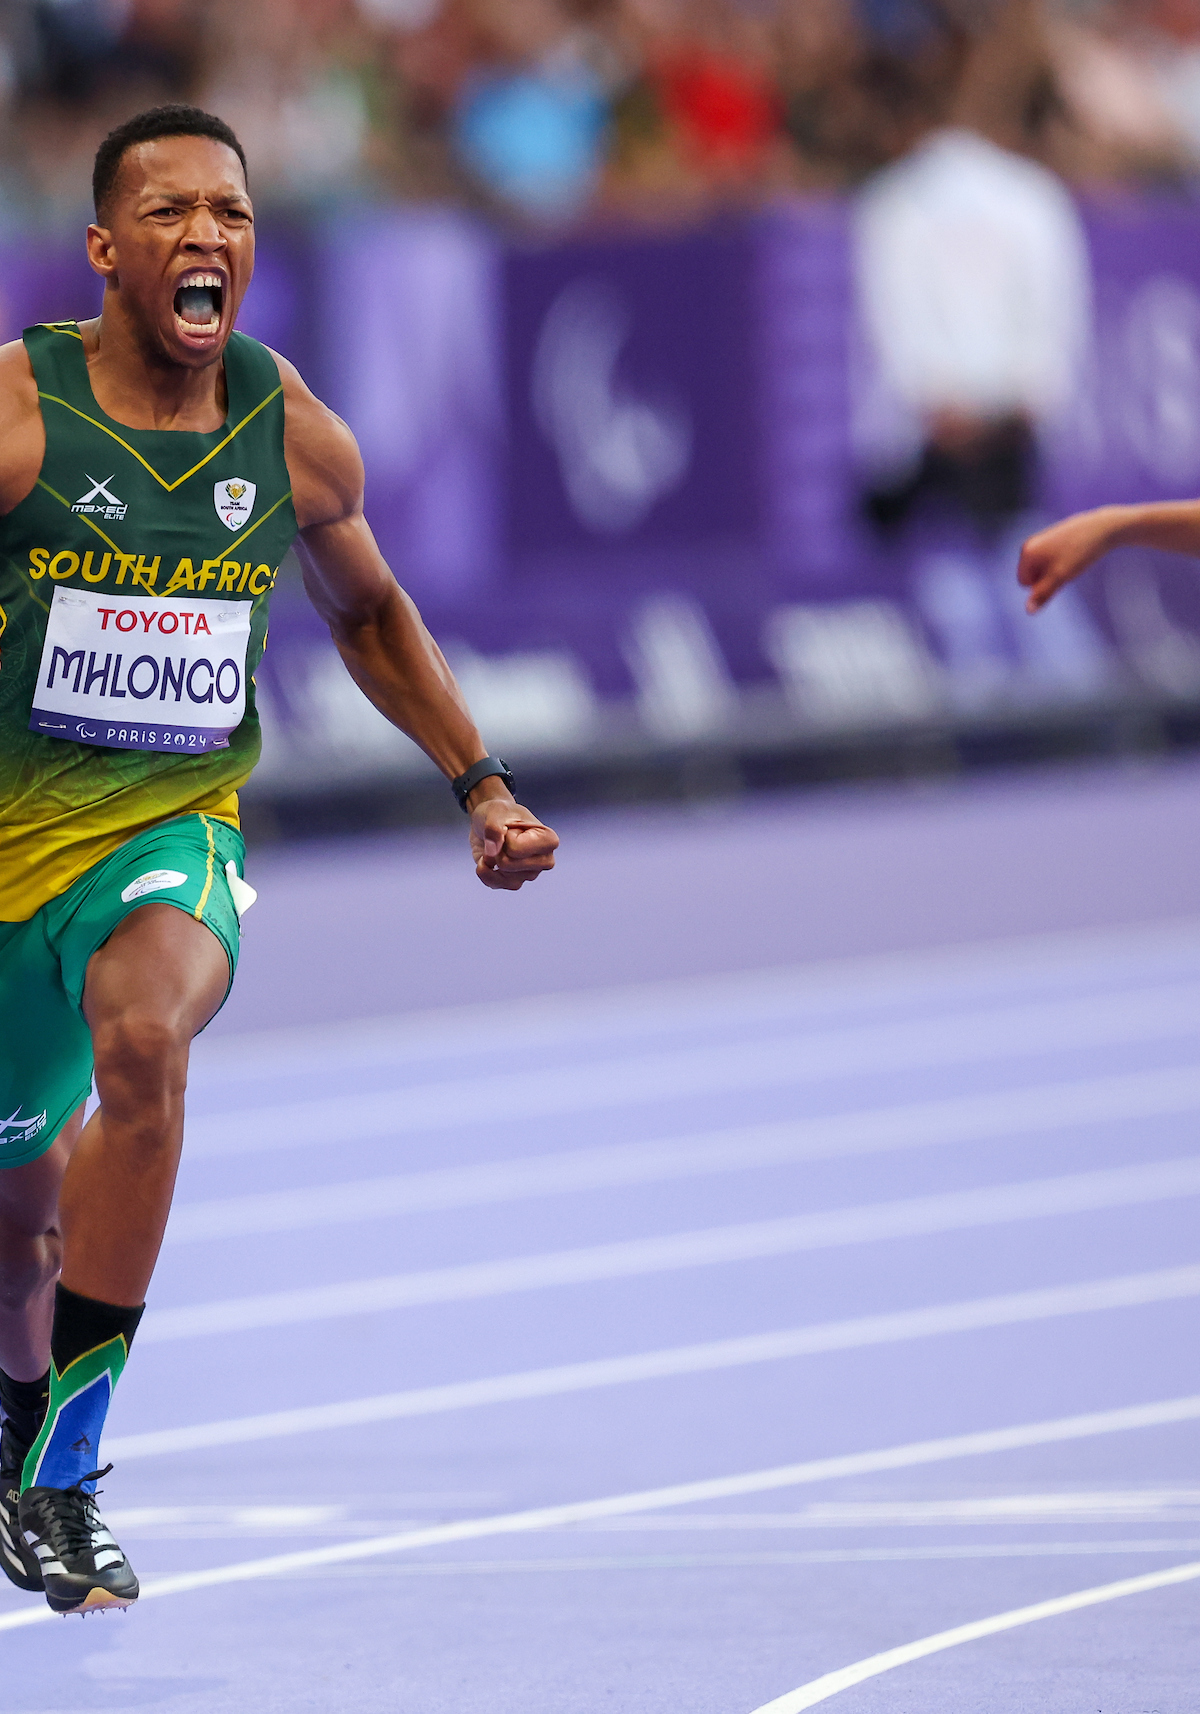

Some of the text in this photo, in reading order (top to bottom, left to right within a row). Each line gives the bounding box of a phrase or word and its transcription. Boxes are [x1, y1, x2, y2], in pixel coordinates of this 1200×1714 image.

[29, 548, 279, 595] SOUTH AFRIC
[97, 608, 212, 635] TOYOTA
[46, 646, 240, 704] MHLONGO
[163, 733, 207, 747] 2024
